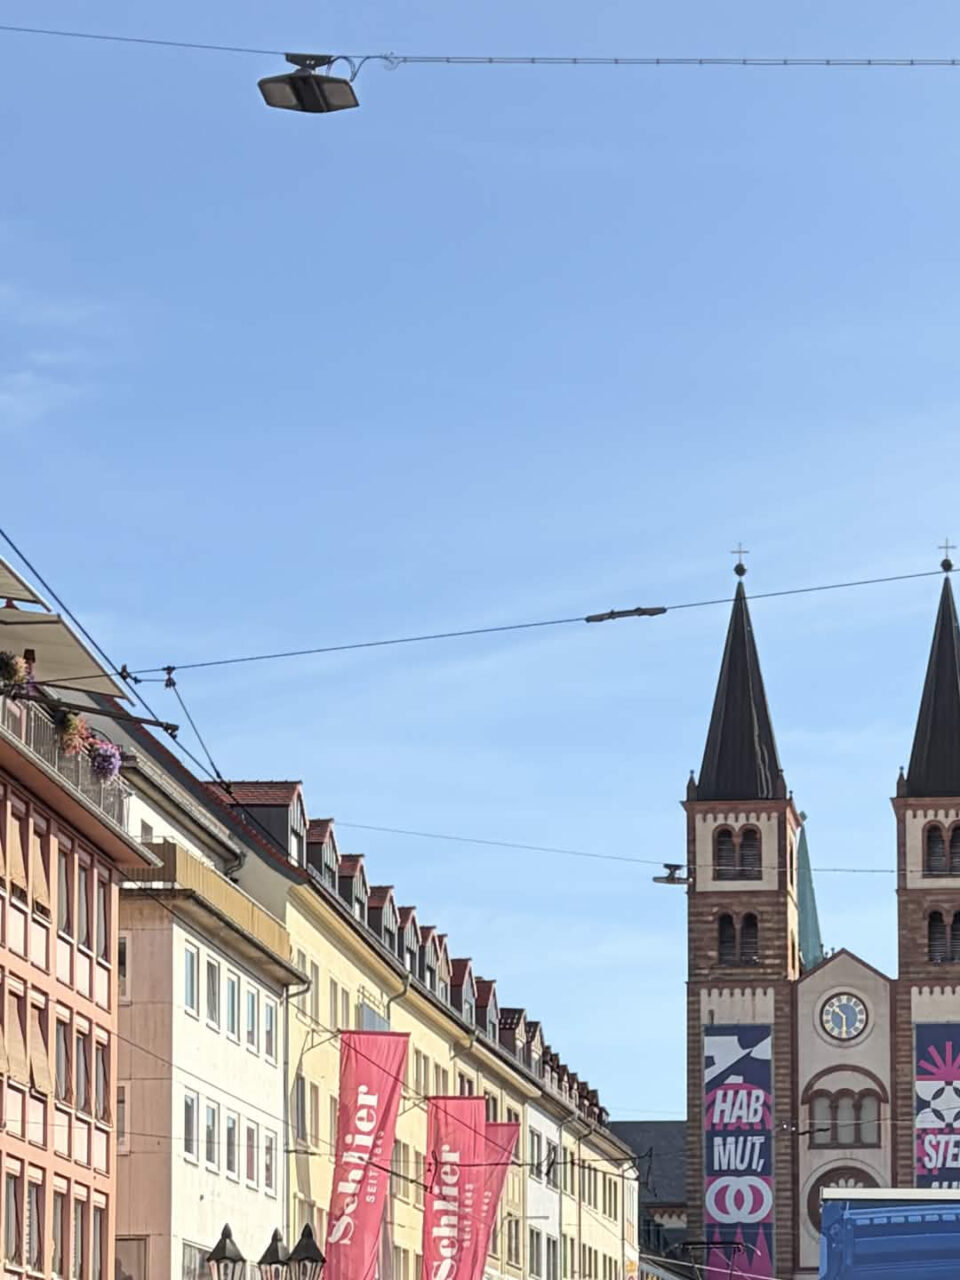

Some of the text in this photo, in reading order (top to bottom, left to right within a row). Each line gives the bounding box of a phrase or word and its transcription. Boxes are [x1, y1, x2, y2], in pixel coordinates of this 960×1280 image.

[713, 1089, 764, 1124] HAB
[327, 1084, 379, 1245] Schlier
[713, 1136, 765, 1172] MUT,
